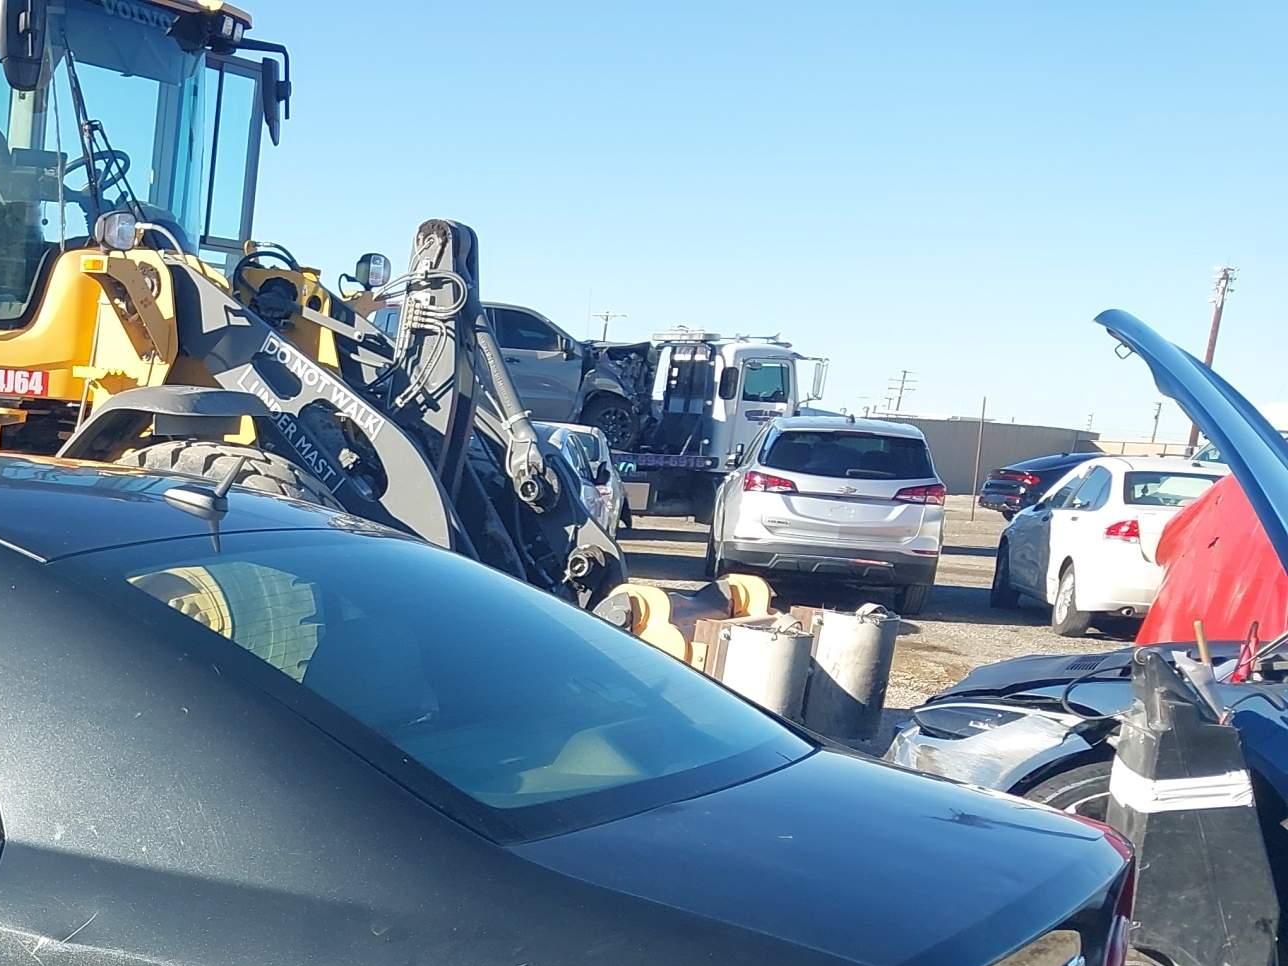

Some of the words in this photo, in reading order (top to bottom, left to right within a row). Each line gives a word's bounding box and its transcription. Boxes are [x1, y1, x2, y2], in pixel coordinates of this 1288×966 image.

[249, 380, 298, 440] UNDER
[295, 435, 337, 481] MAST
[264, 336, 291, 364] DO
[291, 357, 332, 394] NOT
[330, 386, 379, 434] WALK
